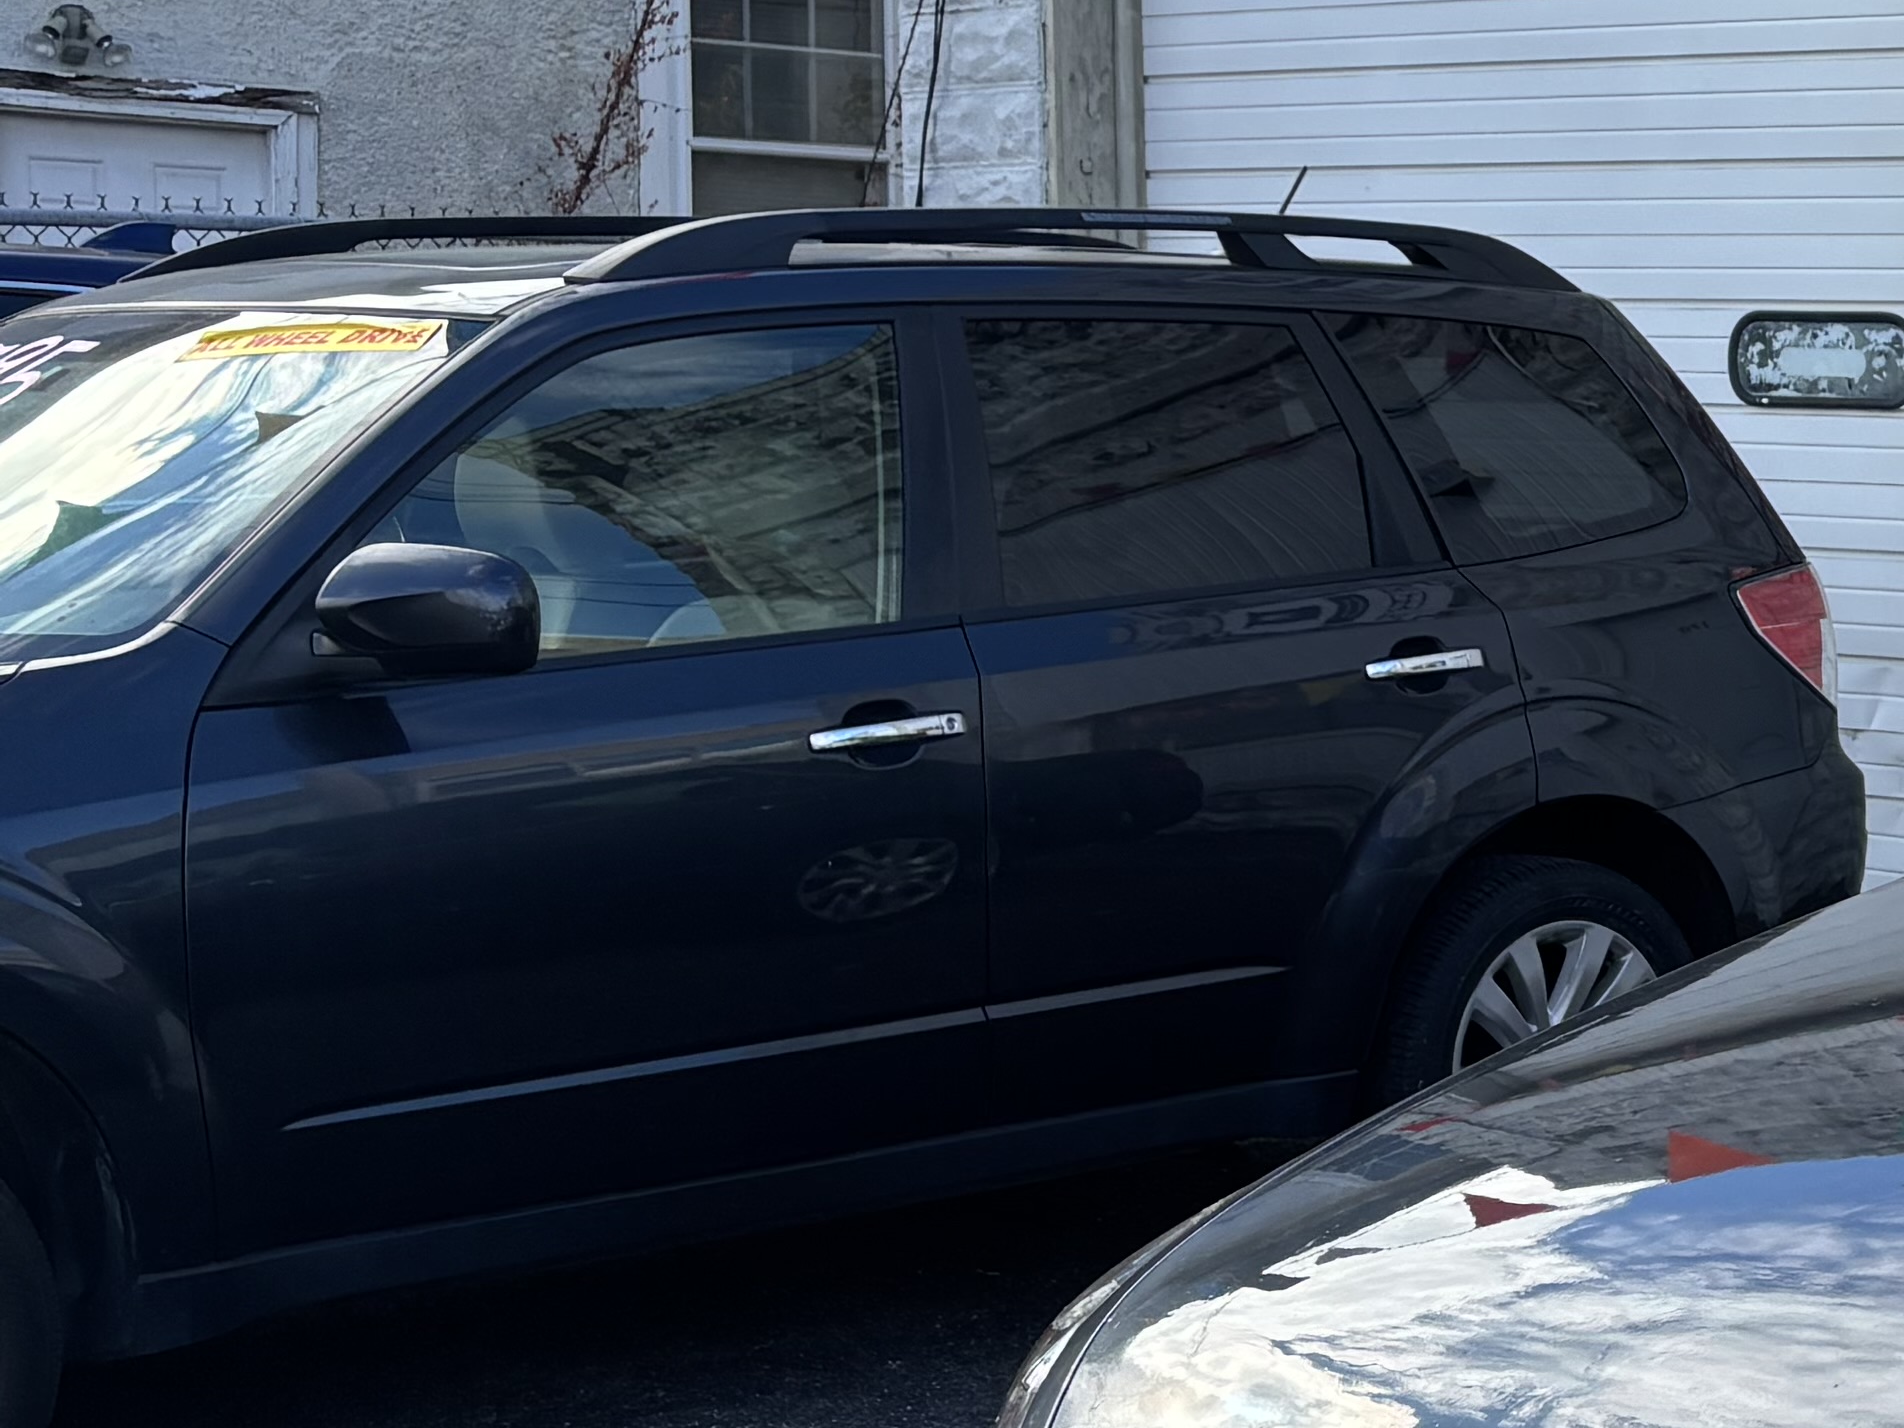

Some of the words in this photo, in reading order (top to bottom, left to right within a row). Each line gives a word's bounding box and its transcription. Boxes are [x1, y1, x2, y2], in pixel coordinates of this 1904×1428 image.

[193, 336, 243, 352] ALL
[242, 330, 337, 349] WHEEL
[336, 328, 433, 345] DRIVE
